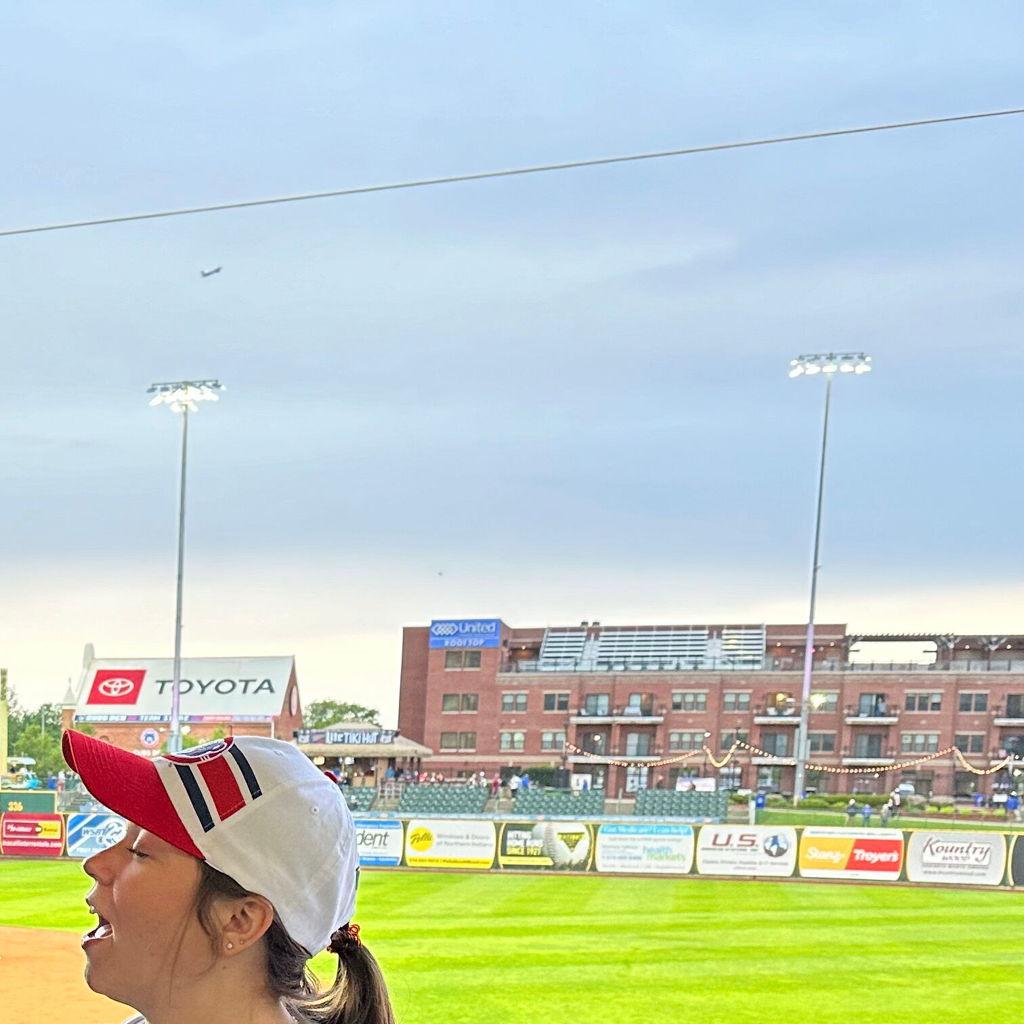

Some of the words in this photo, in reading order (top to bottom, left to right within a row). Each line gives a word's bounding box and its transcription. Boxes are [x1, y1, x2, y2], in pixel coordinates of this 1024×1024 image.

[458, 622, 496, 634] United
[155, 679, 275, 695] TOYOTA
[356, 830, 389, 846] dent
[922, 836, 991, 863] Kountry
